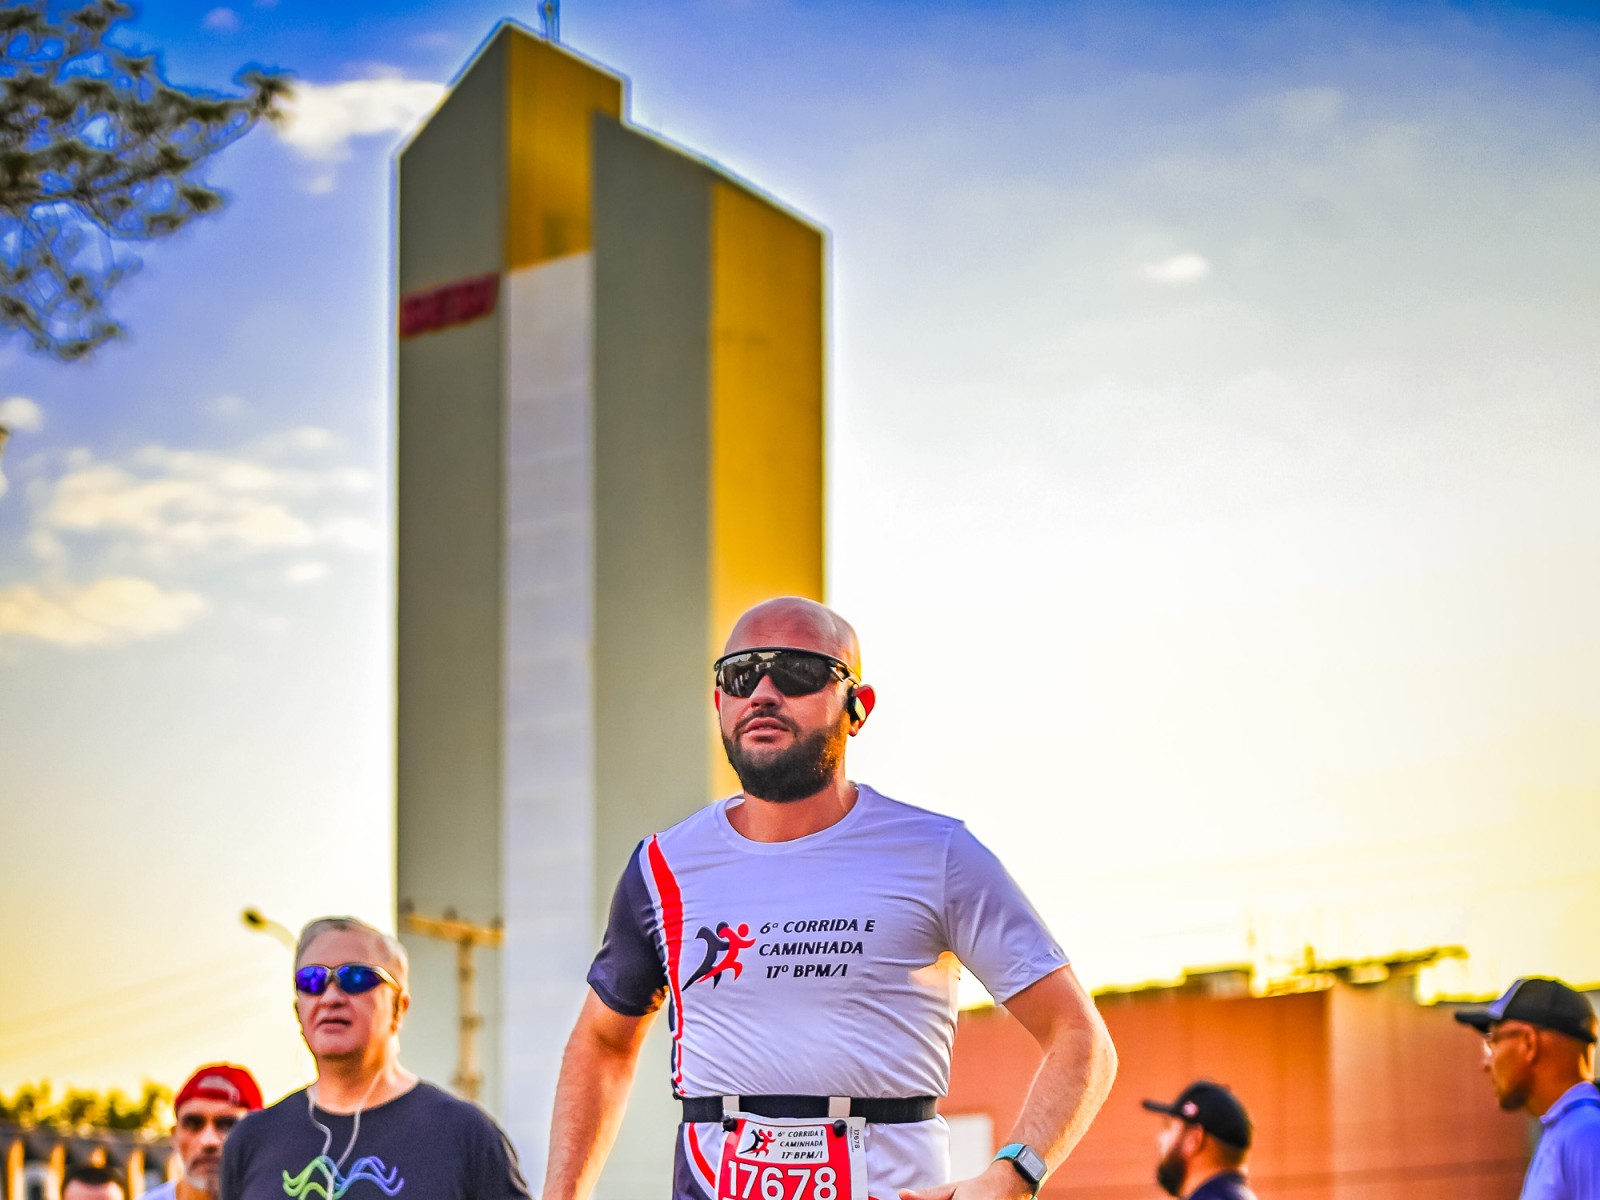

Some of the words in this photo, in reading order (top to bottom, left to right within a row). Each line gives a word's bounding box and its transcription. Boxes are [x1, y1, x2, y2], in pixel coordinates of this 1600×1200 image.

[783, 919, 859, 934] CORRIDA
[864, 919, 876, 932] E
[759, 941, 864, 956] CAMINHADA
[793, 963, 848, 978] BPM/I
[788, 1130, 819, 1138] CORRIDA
[820, 1129, 824, 1137] E
[853, 1128, 861, 1150] 17678
[779, 1140, 823, 1148] CAMINHADA
